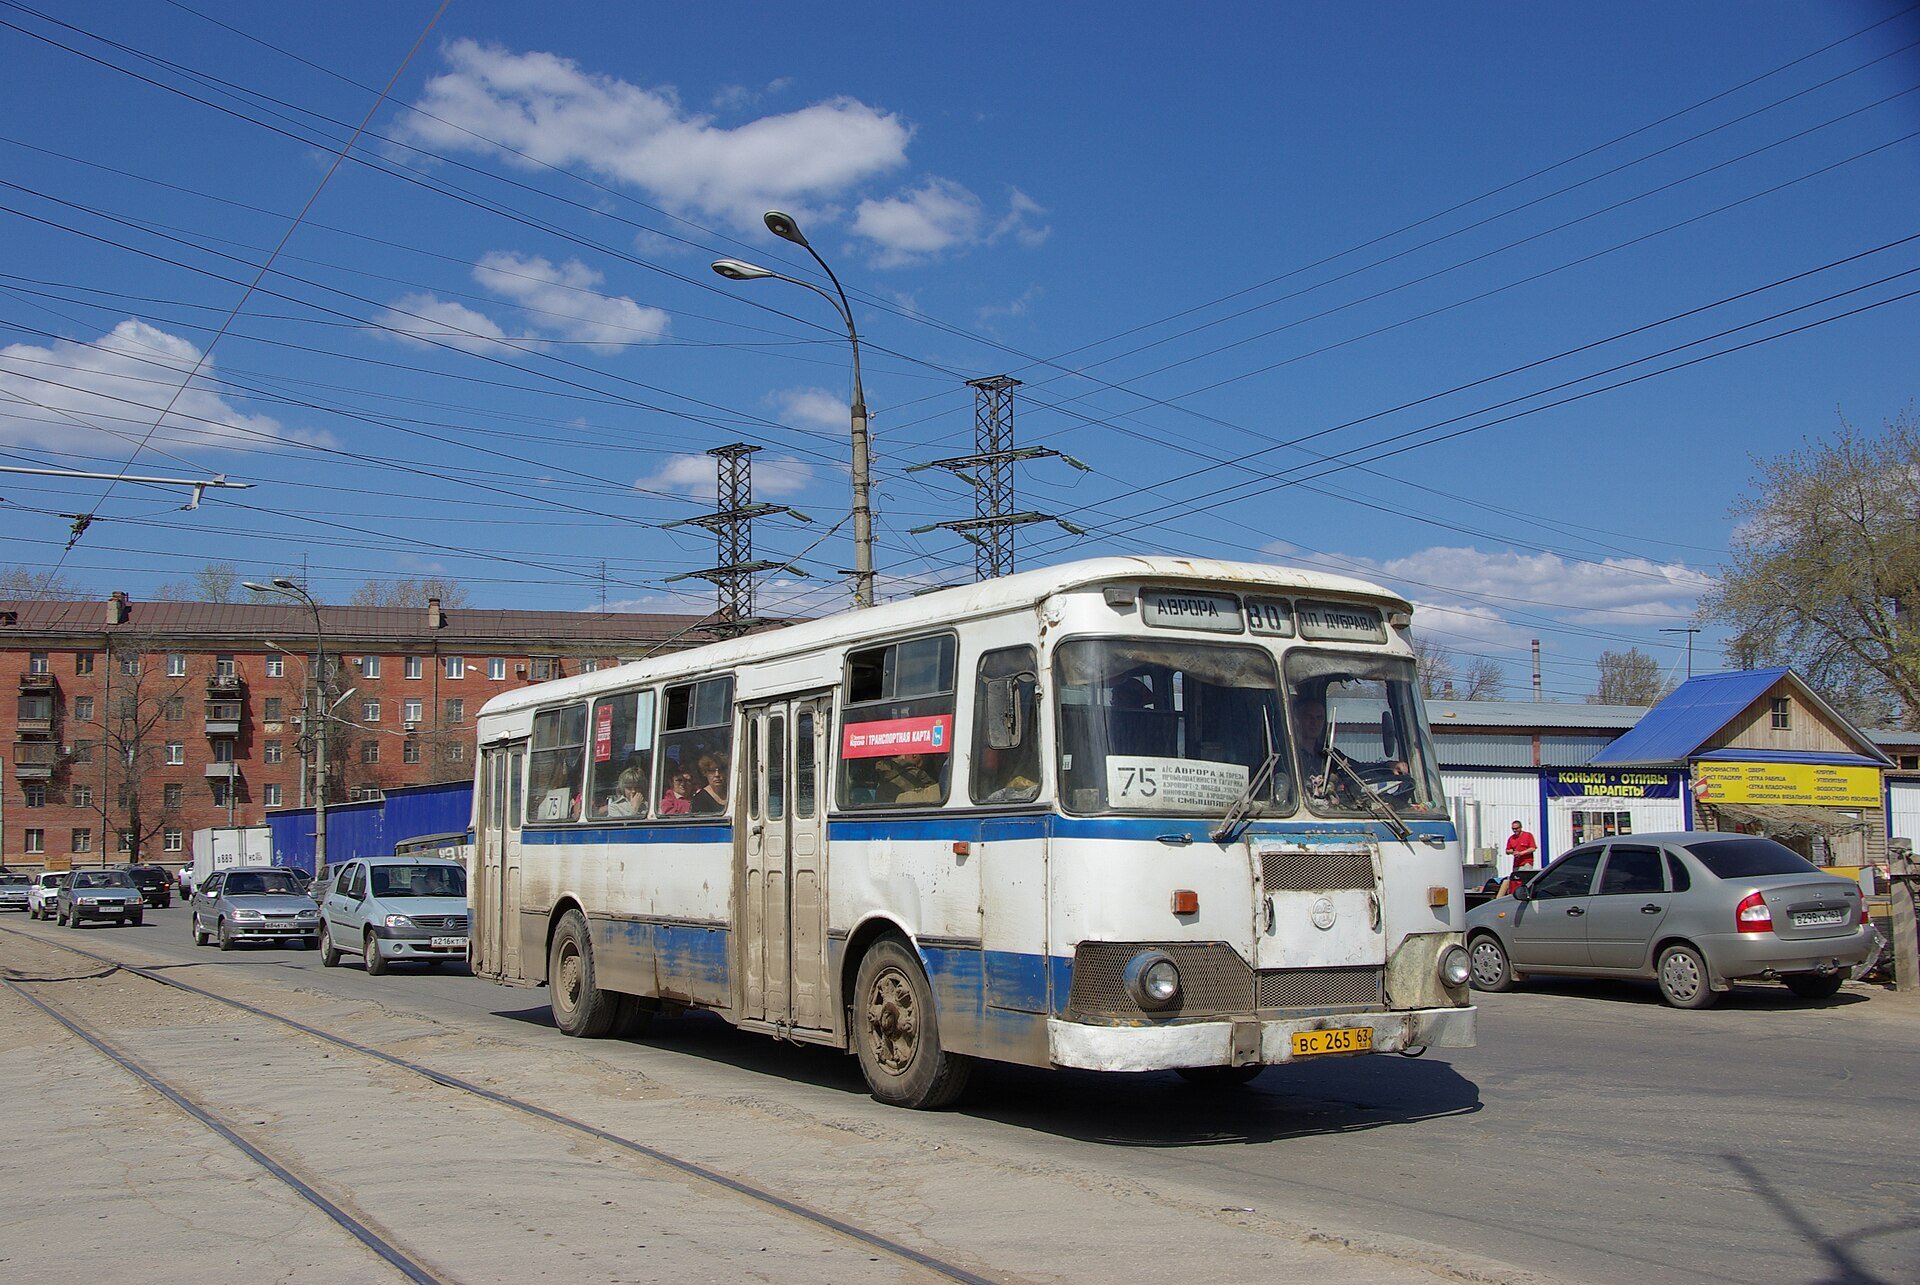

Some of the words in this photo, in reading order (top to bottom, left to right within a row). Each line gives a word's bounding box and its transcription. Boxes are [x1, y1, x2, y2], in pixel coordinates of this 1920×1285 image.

[1158, 598, 1219, 617] АВРОРА
[1324, 610, 1377, 632] ДУБРАВА
[868, 731, 910, 746] ТРАНСПОРТНАЯ
[912, 730, 931, 742] КАРТА
[1174, 766, 1216, 777] АВРОРА
[1558, 772, 1606, 784] КОНЬКИ
[1621, 773, 1668, 785] ОТЛИВЫ
[1117, 767, 1158, 798] 75
[1584, 785, 1645, 796] ПАРАПЕТЫ
[1300, 1038, 1318, 1051] ВС
[1325, 1031, 1351, 1050] 265
[1356, 1029, 1368, 1043] 63
